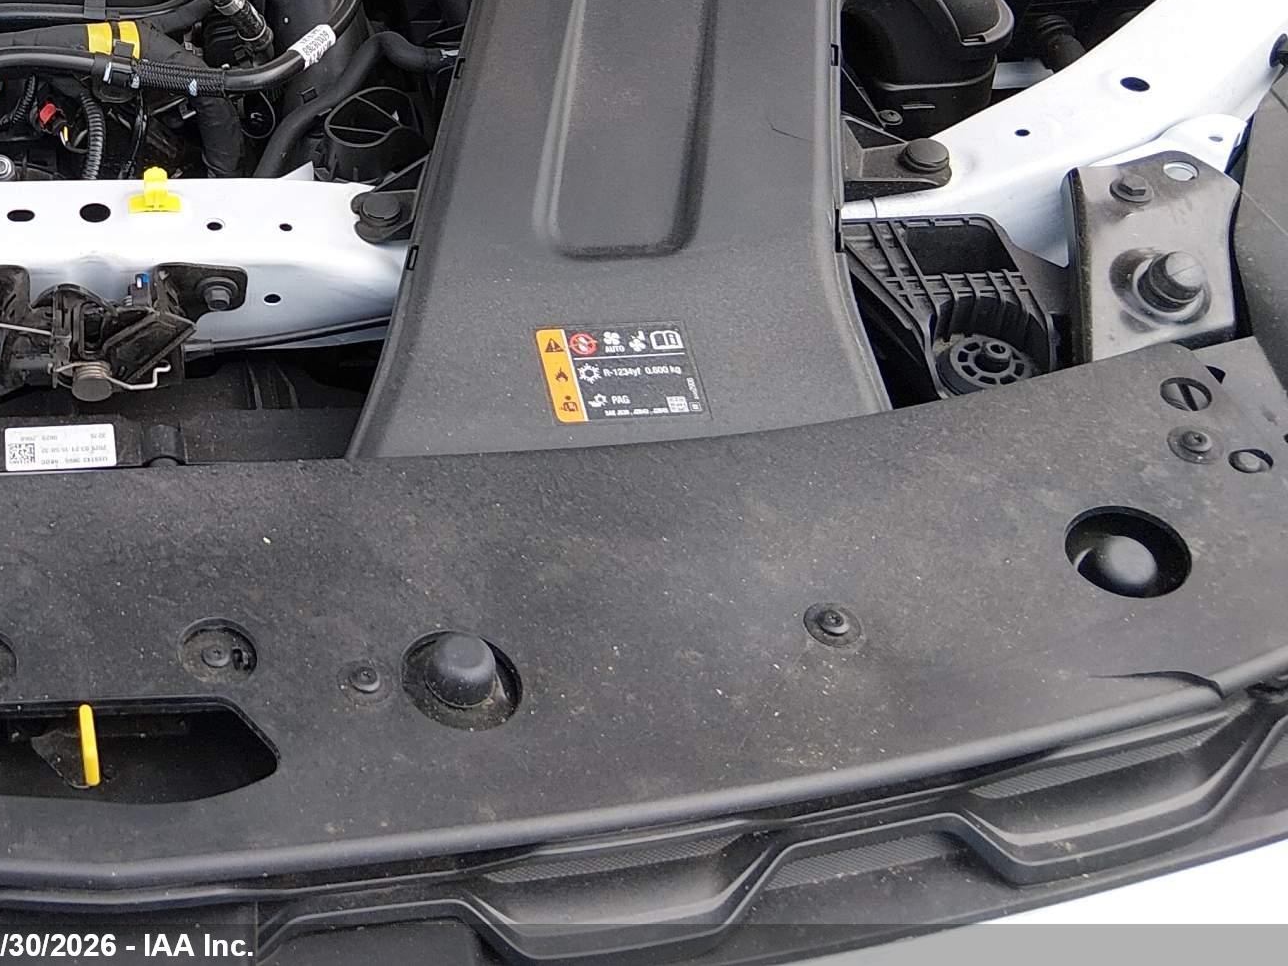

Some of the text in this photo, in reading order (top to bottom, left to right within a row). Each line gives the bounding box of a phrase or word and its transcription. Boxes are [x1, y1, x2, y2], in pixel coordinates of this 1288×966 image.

[604, 344, 625, 354] AUTO
[602, 365, 642, 378] R-1234yf
[670, 364, 682, 376] kg
[610, 395, 631, 405] PAG
